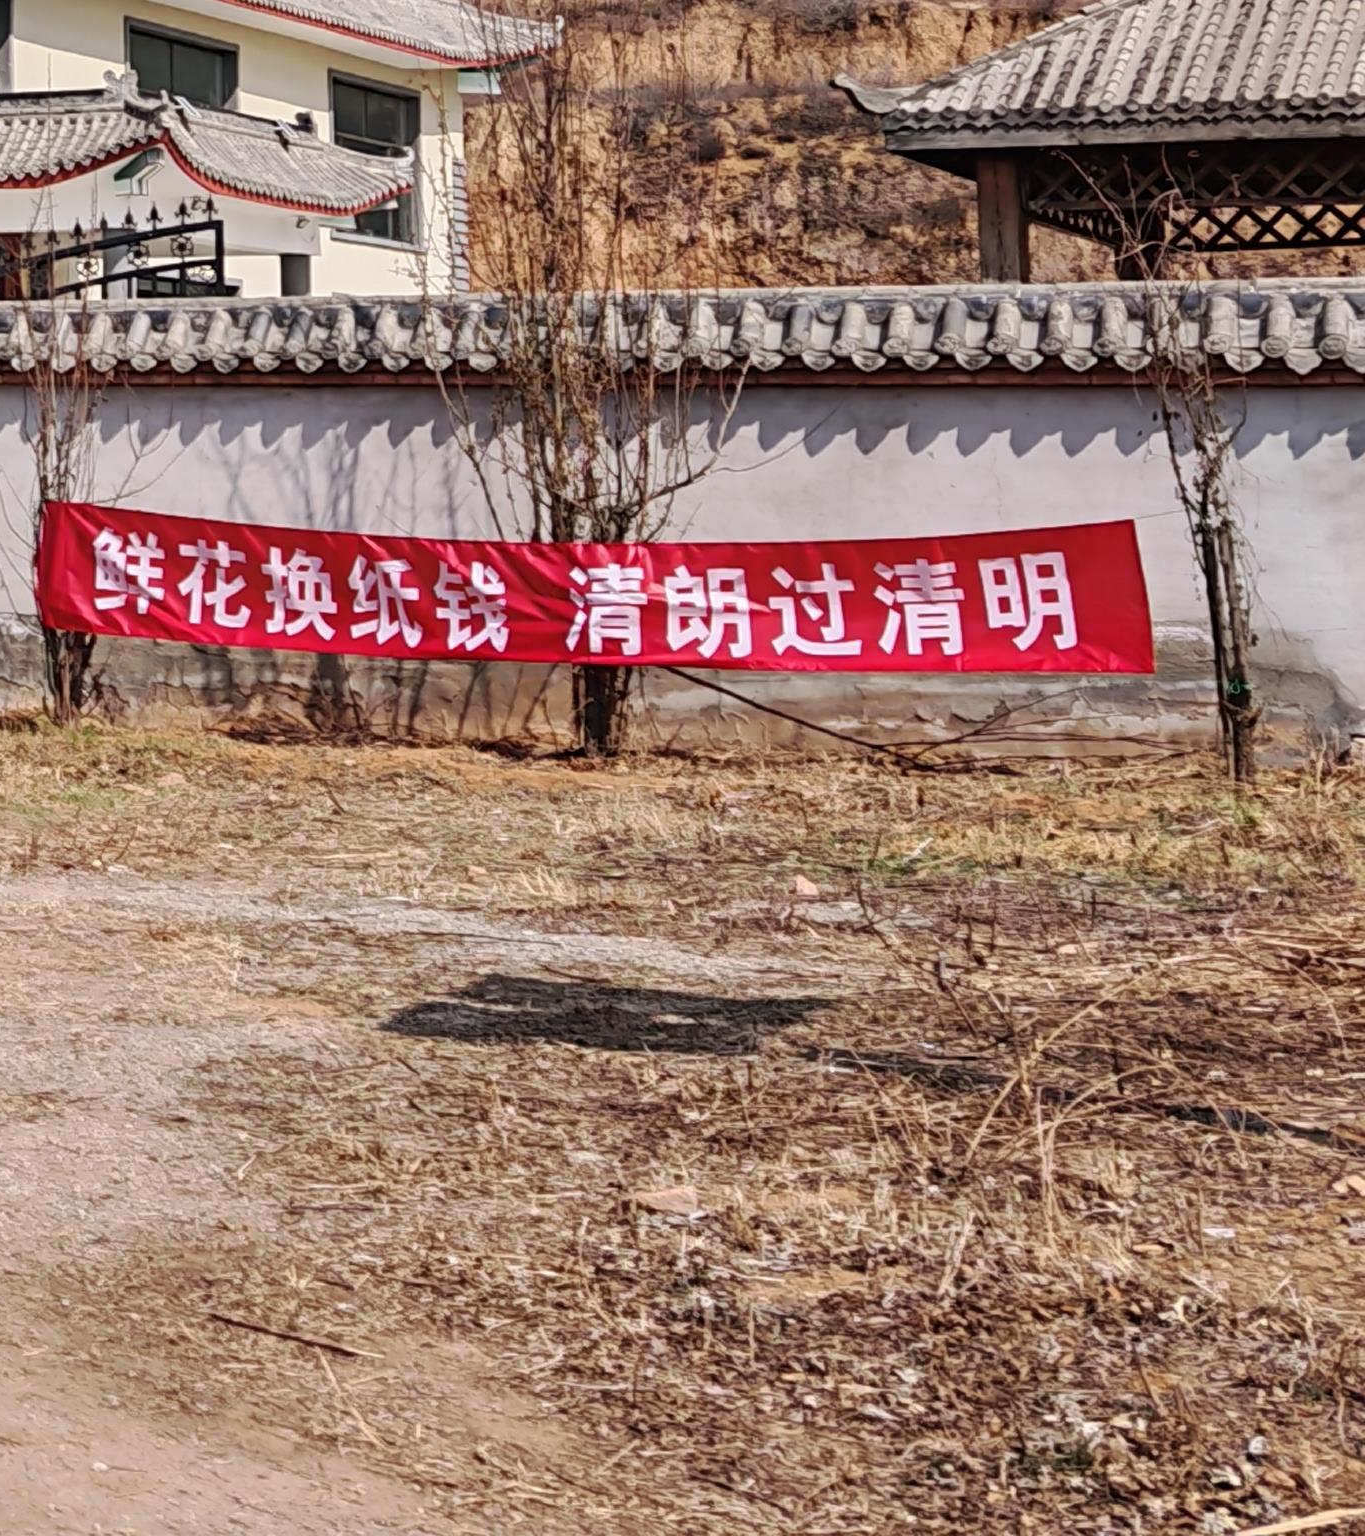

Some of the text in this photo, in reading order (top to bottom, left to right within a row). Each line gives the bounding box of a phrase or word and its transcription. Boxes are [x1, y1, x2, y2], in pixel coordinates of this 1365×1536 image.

[92, 526, 1077, 659] 鲜花换纸钱 清朗过清明
